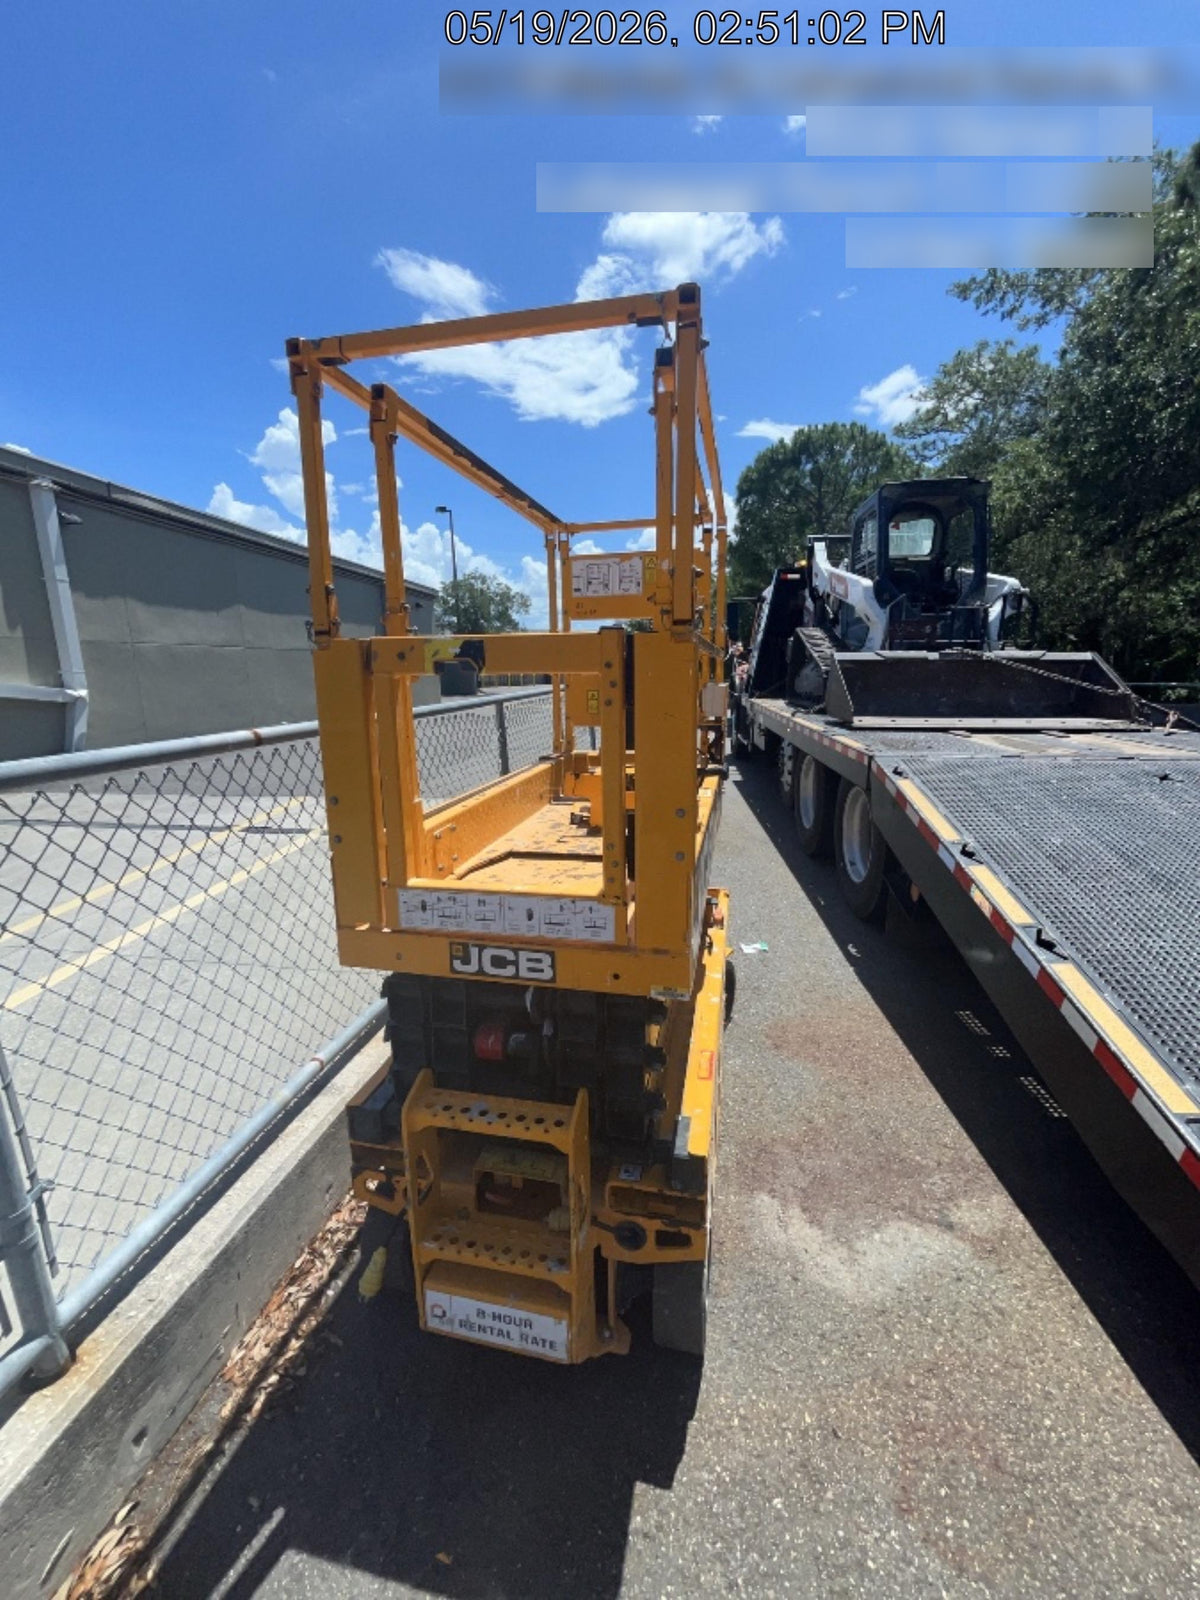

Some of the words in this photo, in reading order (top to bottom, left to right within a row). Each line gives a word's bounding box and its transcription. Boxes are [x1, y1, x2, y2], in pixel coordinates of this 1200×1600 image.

[452, 944, 554, 980] JCB
[458, 1318, 514, 1341] RENTAL
[519, 1332, 558, 1352] RATE
